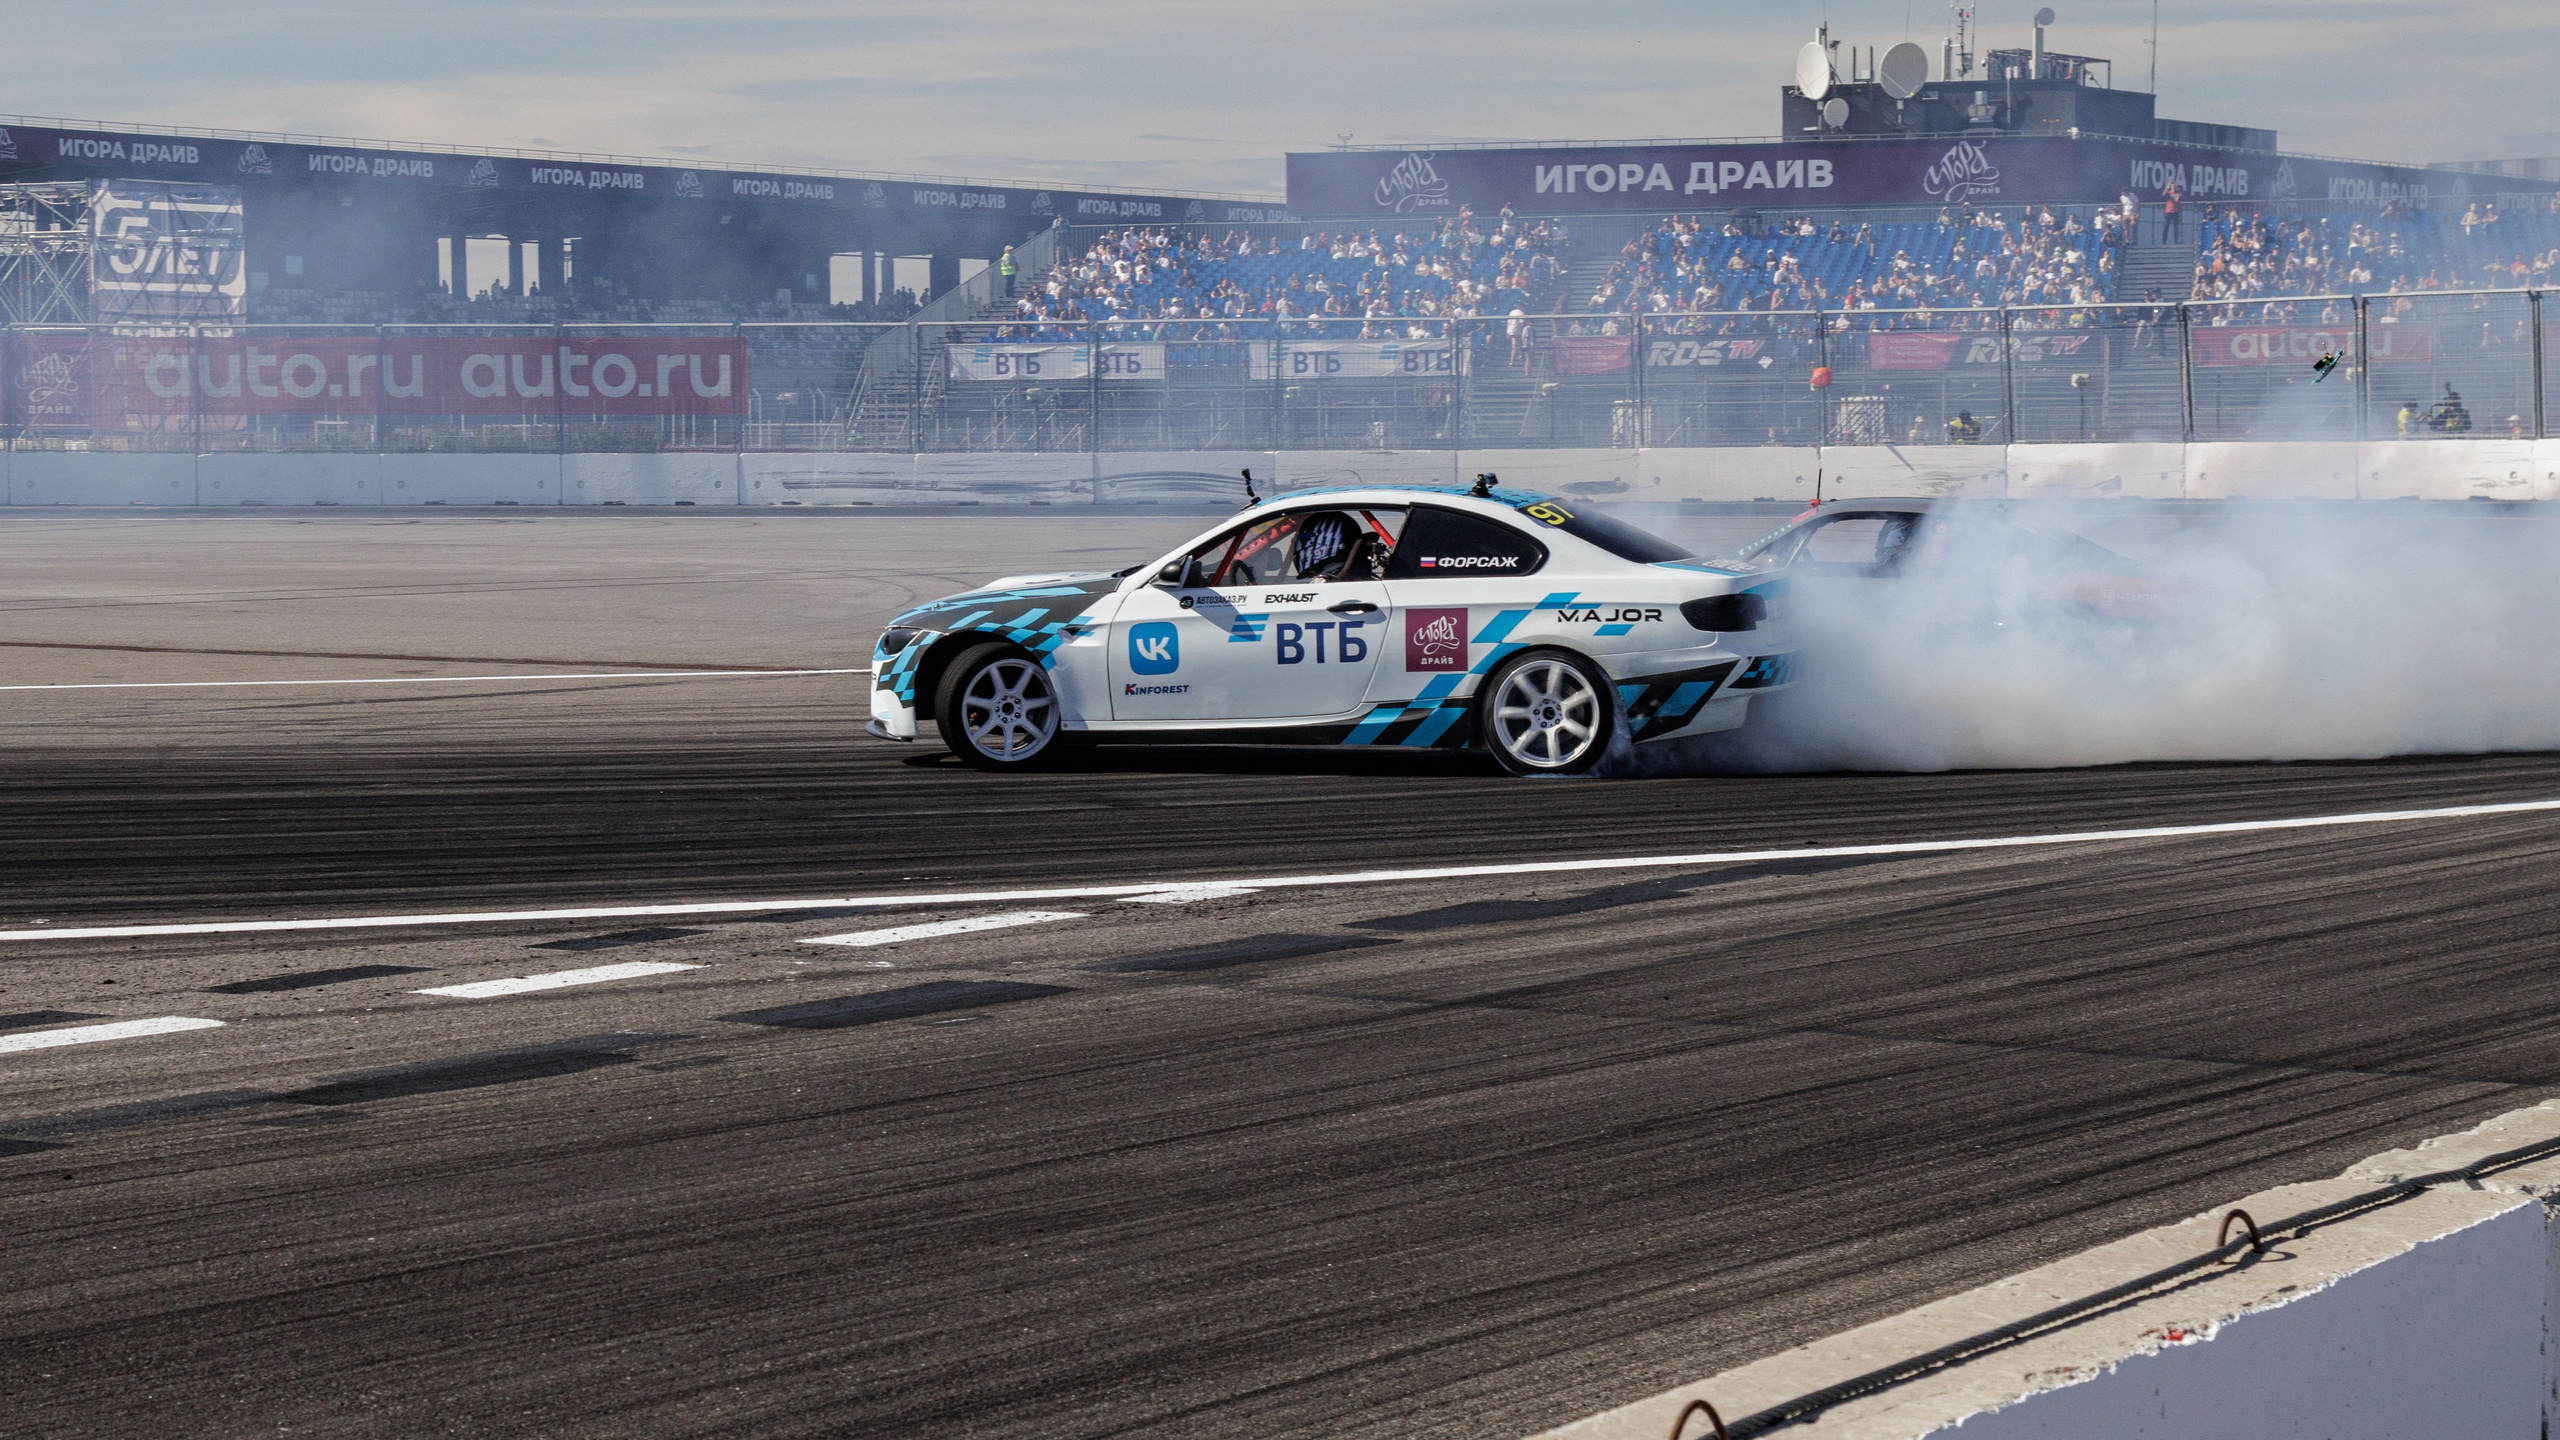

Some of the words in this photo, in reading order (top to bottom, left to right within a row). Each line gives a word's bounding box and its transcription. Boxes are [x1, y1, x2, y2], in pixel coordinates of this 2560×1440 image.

[59, 138, 126, 160] ИГОРА
[309, 154, 368, 174] ИГОРА
[531, 167, 585, 187] ИГОРА
[1535, 163, 1674, 193] ИГОРА
[1685, 159, 1834, 194] ДРАЙВ
[2130, 159, 2187, 191] ИГОРА
[733, 179, 781, 197] ИГОРА
[913, 190, 957, 206] ИГОРА
[1077, 199, 1118, 215] ИГОРА
[1227, 207, 1265, 222] ИГОРА
[109, 217, 149, 275] 5
[995, 352, 1041, 375] ВТБ
[1293, 350, 1341, 373] ВТБ
[1403, 349, 1450, 372] ВТБ
[144, 346, 424, 398] auto.ru
[461, 346, 732, 398] auto.ru
[27, 403, 73, 415] ДРАЙВ
[1438, 556, 1519, 568] ФОРСАЖ
[1195, 594, 1248, 605] АВТОЗАКАЗ.РУ
[1264, 592, 1320, 604] EXHAUST
[1557, 608, 1664, 623] MAJOR
[1276, 620, 1368, 665] ВТБ
[1420, 655, 1454, 665] ДРАЙВ
[1124, 683, 1190, 696] KINFOREST
